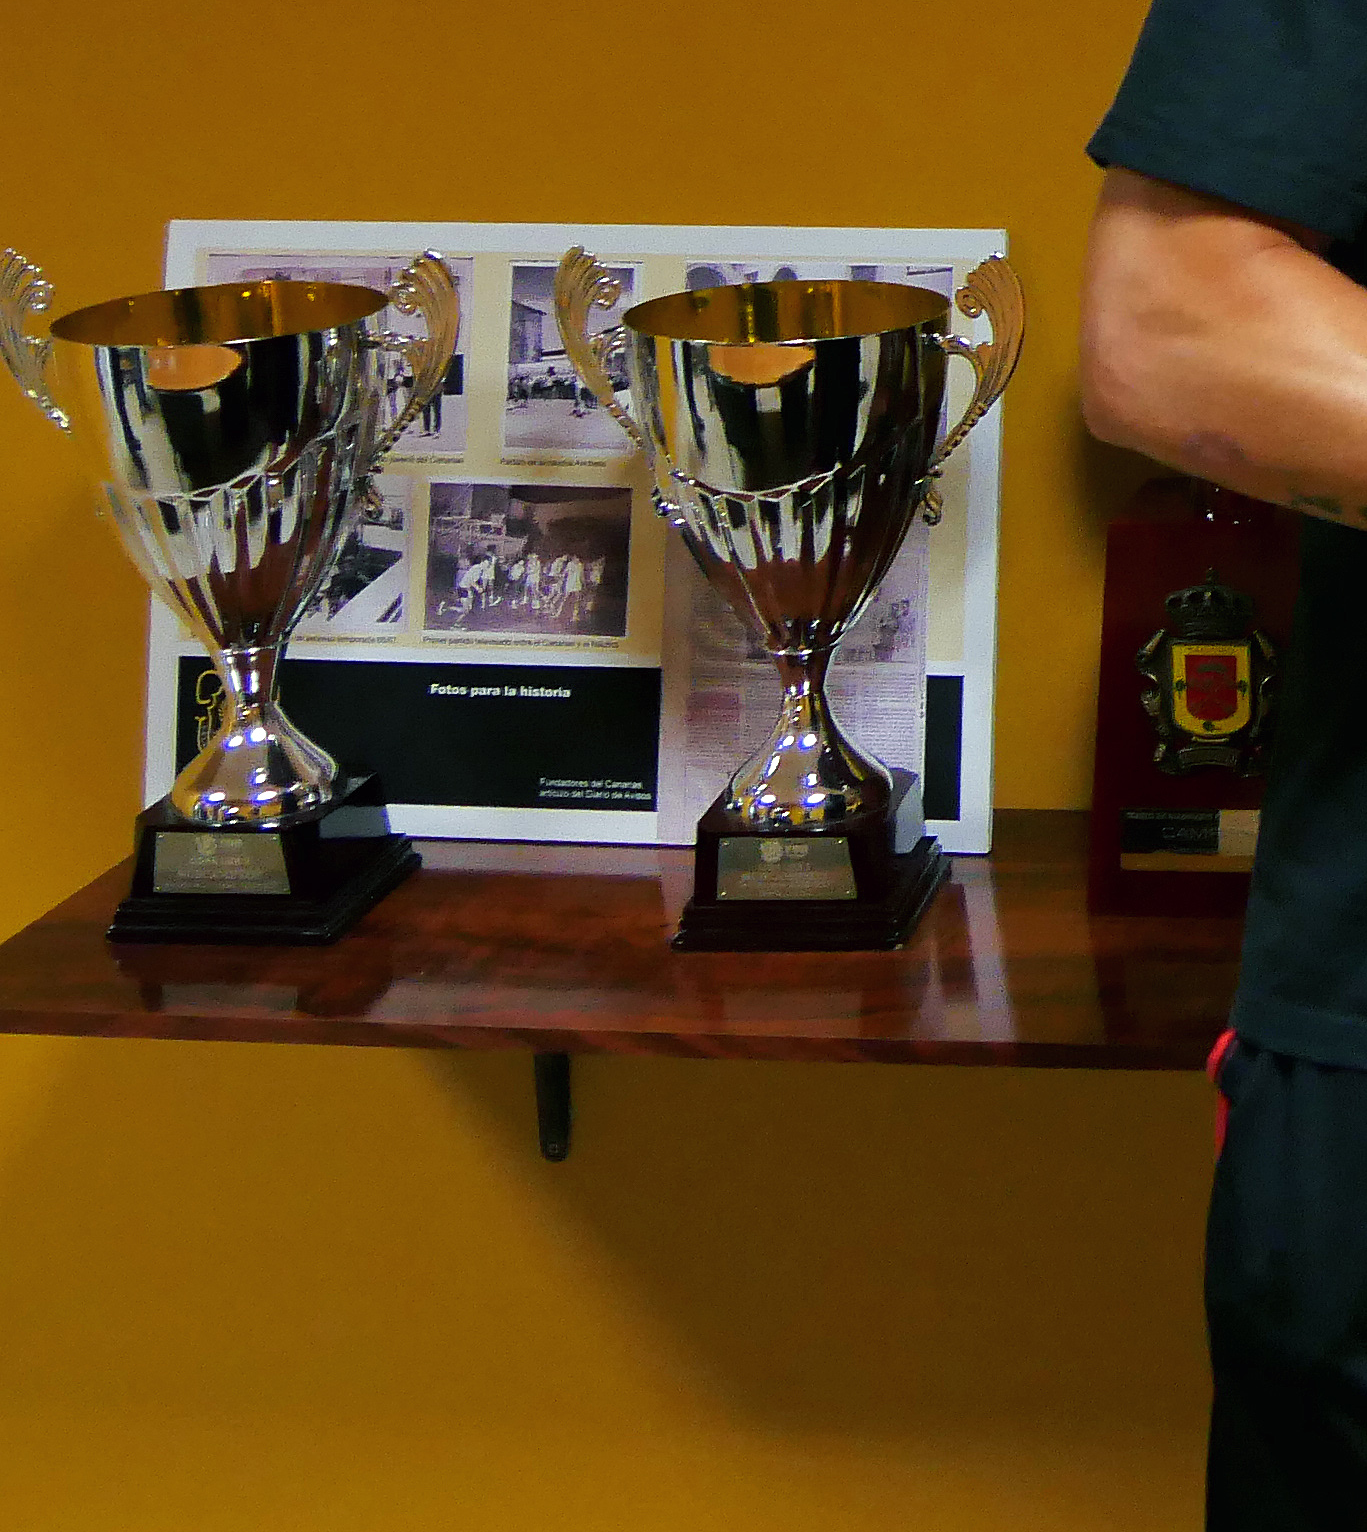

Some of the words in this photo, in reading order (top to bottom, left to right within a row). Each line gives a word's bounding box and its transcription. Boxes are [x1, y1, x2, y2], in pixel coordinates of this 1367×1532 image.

[429, 683, 468, 695] Fotos
[470, 686, 501, 697] para
[504, 685, 517, 696] la
[520, 685, 571, 698] historia
